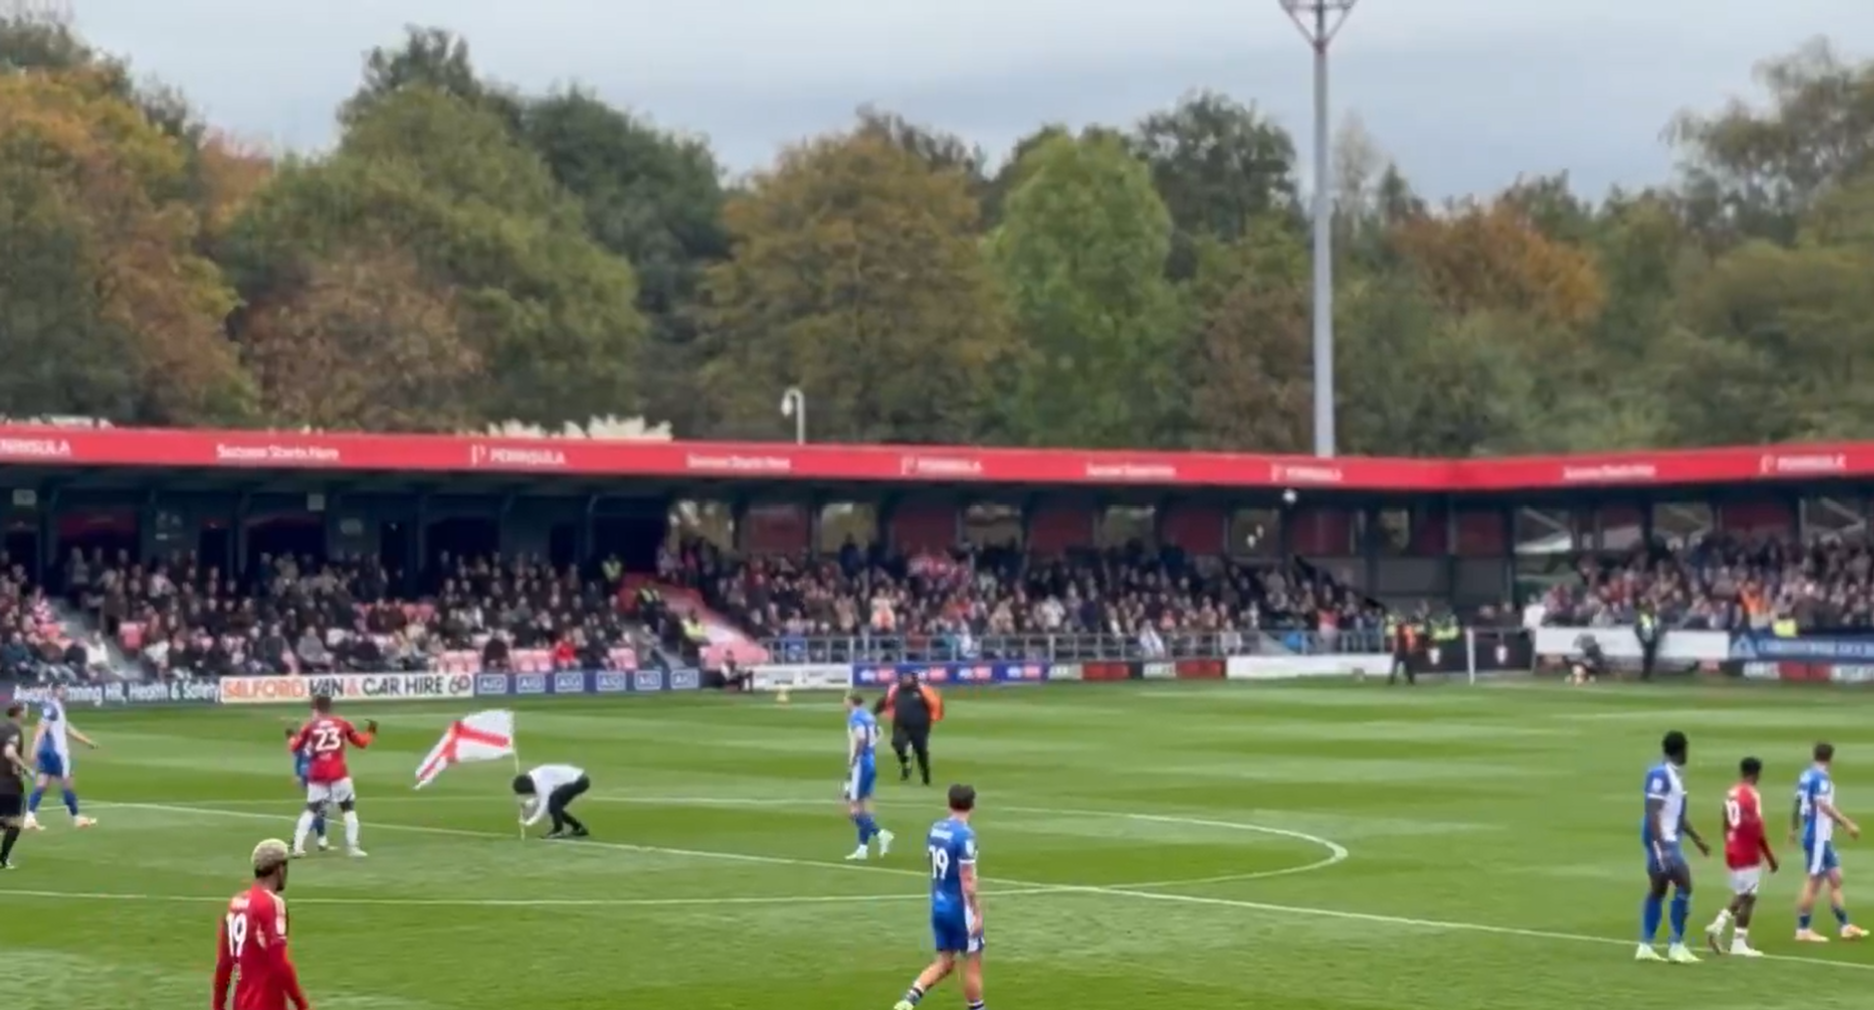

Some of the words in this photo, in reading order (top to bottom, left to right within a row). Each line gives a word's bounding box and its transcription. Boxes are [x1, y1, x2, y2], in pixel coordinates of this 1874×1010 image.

[223, 678, 304, 698] SALFORD
[308, 677, 344, 697] VAN
[362, 677, 400, 696] CAR
[406, 675, 444, 695] HIRE
[312, 727, 342, 751] 23
[929, 845, 949, 880] 19
[226, 911, 247, 957] 19
